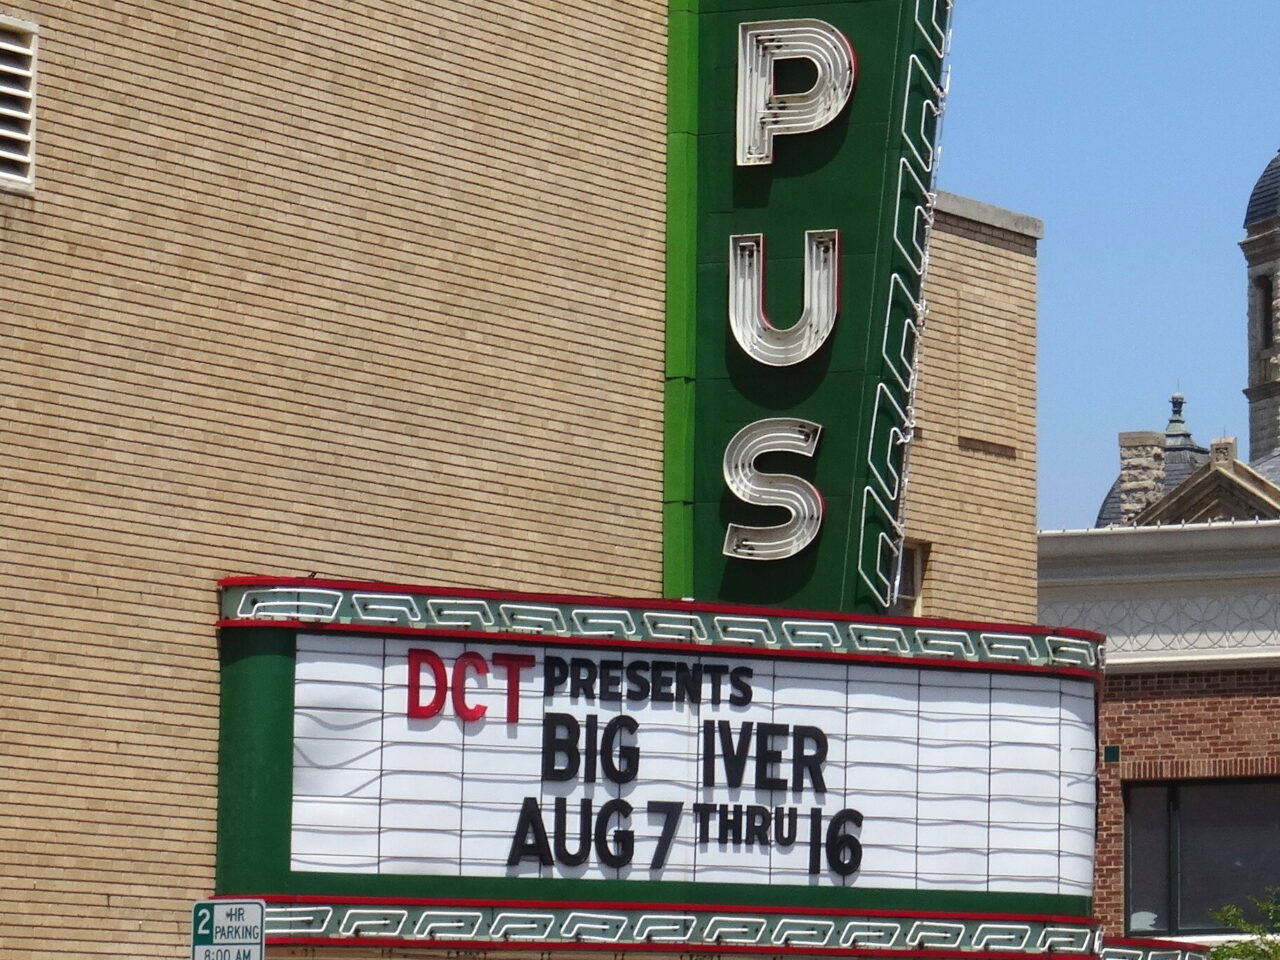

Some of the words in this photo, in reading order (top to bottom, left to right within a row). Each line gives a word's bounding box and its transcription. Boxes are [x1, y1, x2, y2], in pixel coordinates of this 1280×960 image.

[406, 648, 536, 724] DCT
[543, 655, 753, 707] PRESENTS
[541, 712, 641, 784] BIG
[702, 719, 829, 793] IVER
[506, 797, 634, 869] AUG
[647, 800, 684, 870] 7
[694, 803, 798, 847] THRU
[808, 806, 864, 877] 16
[197, 908, 211, 935] 2
[229, 907, 245, 922] HR
[214, 925, 259, 940] PARKING
[204, 949, 231, 960] 8:00
[236, 949, 252, 960] AM
